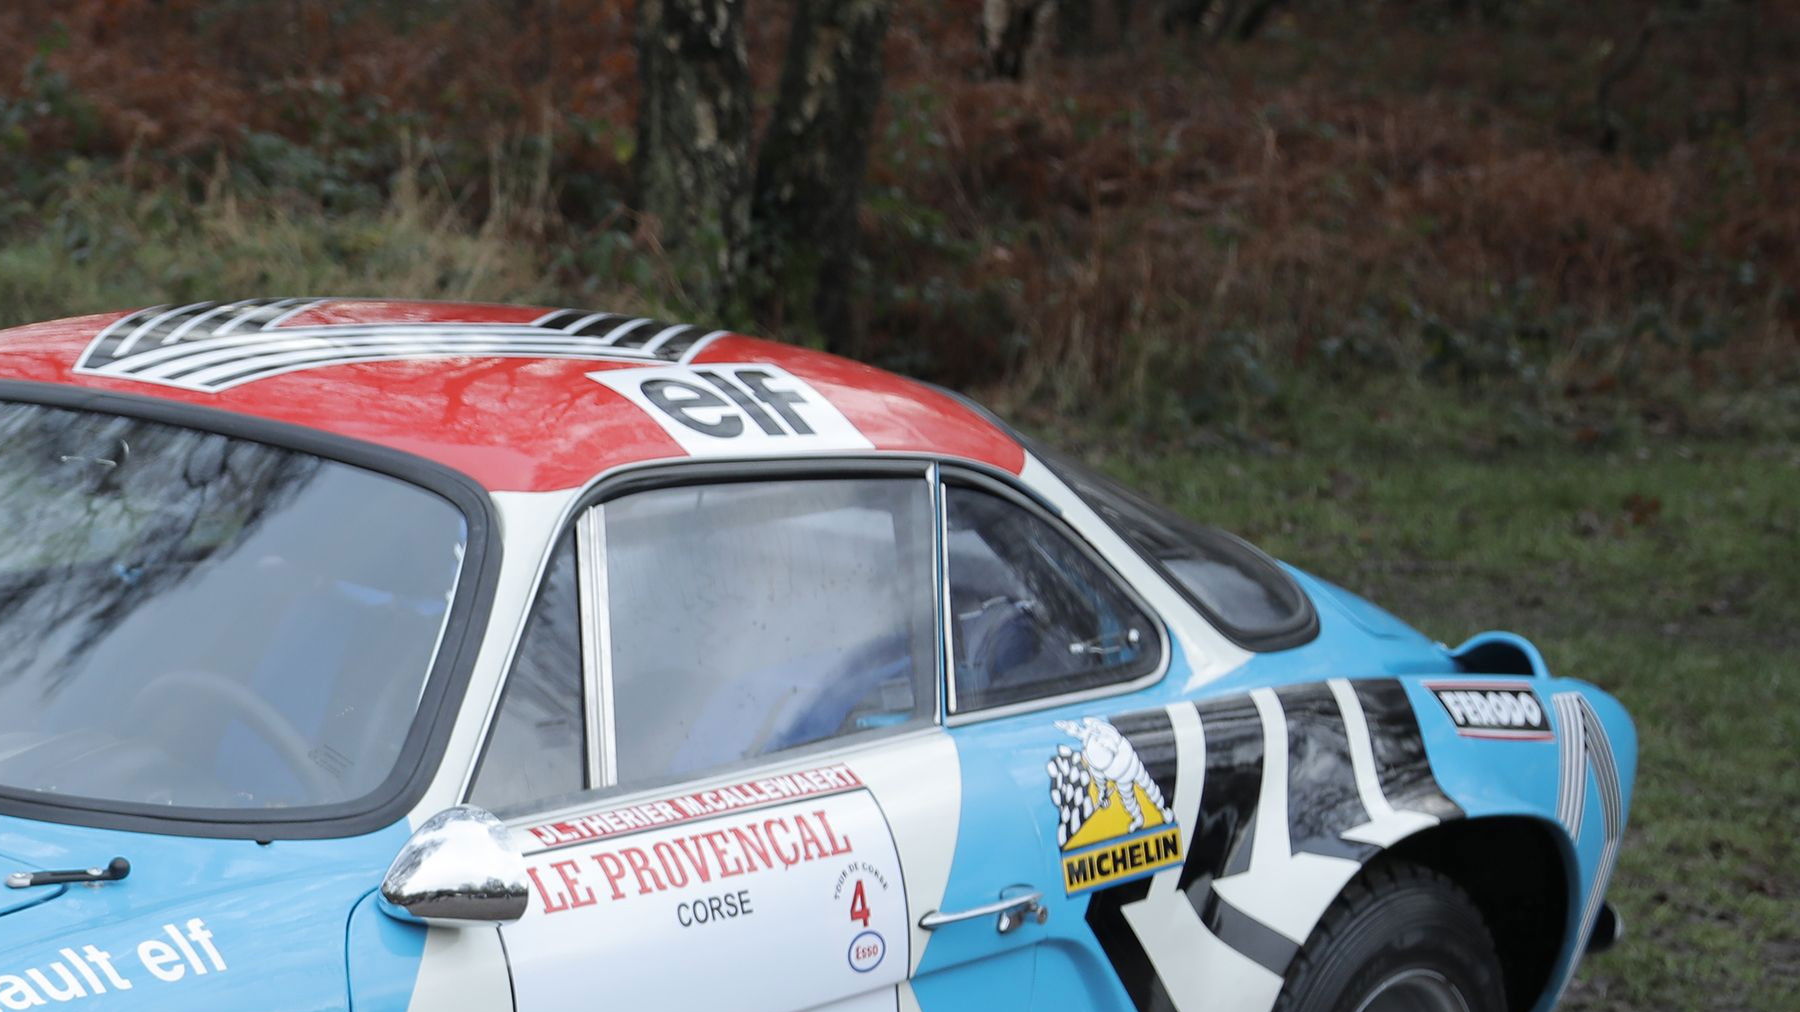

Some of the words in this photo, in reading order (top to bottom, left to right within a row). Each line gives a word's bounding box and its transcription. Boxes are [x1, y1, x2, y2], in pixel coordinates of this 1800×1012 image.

[640, 370, 817, 438] elf
[1438, 690, 1543, 727] FERODO
[527, 860, 598, 914] LE
[591, 810, 853, 901] PROVENÇAL
[1066, 834, 1179, 887] MICHELIN
[676, 890, 754, 928] CORSE
[850, 879, 871, 927] 4
[137, 917, 228, 982] elf
